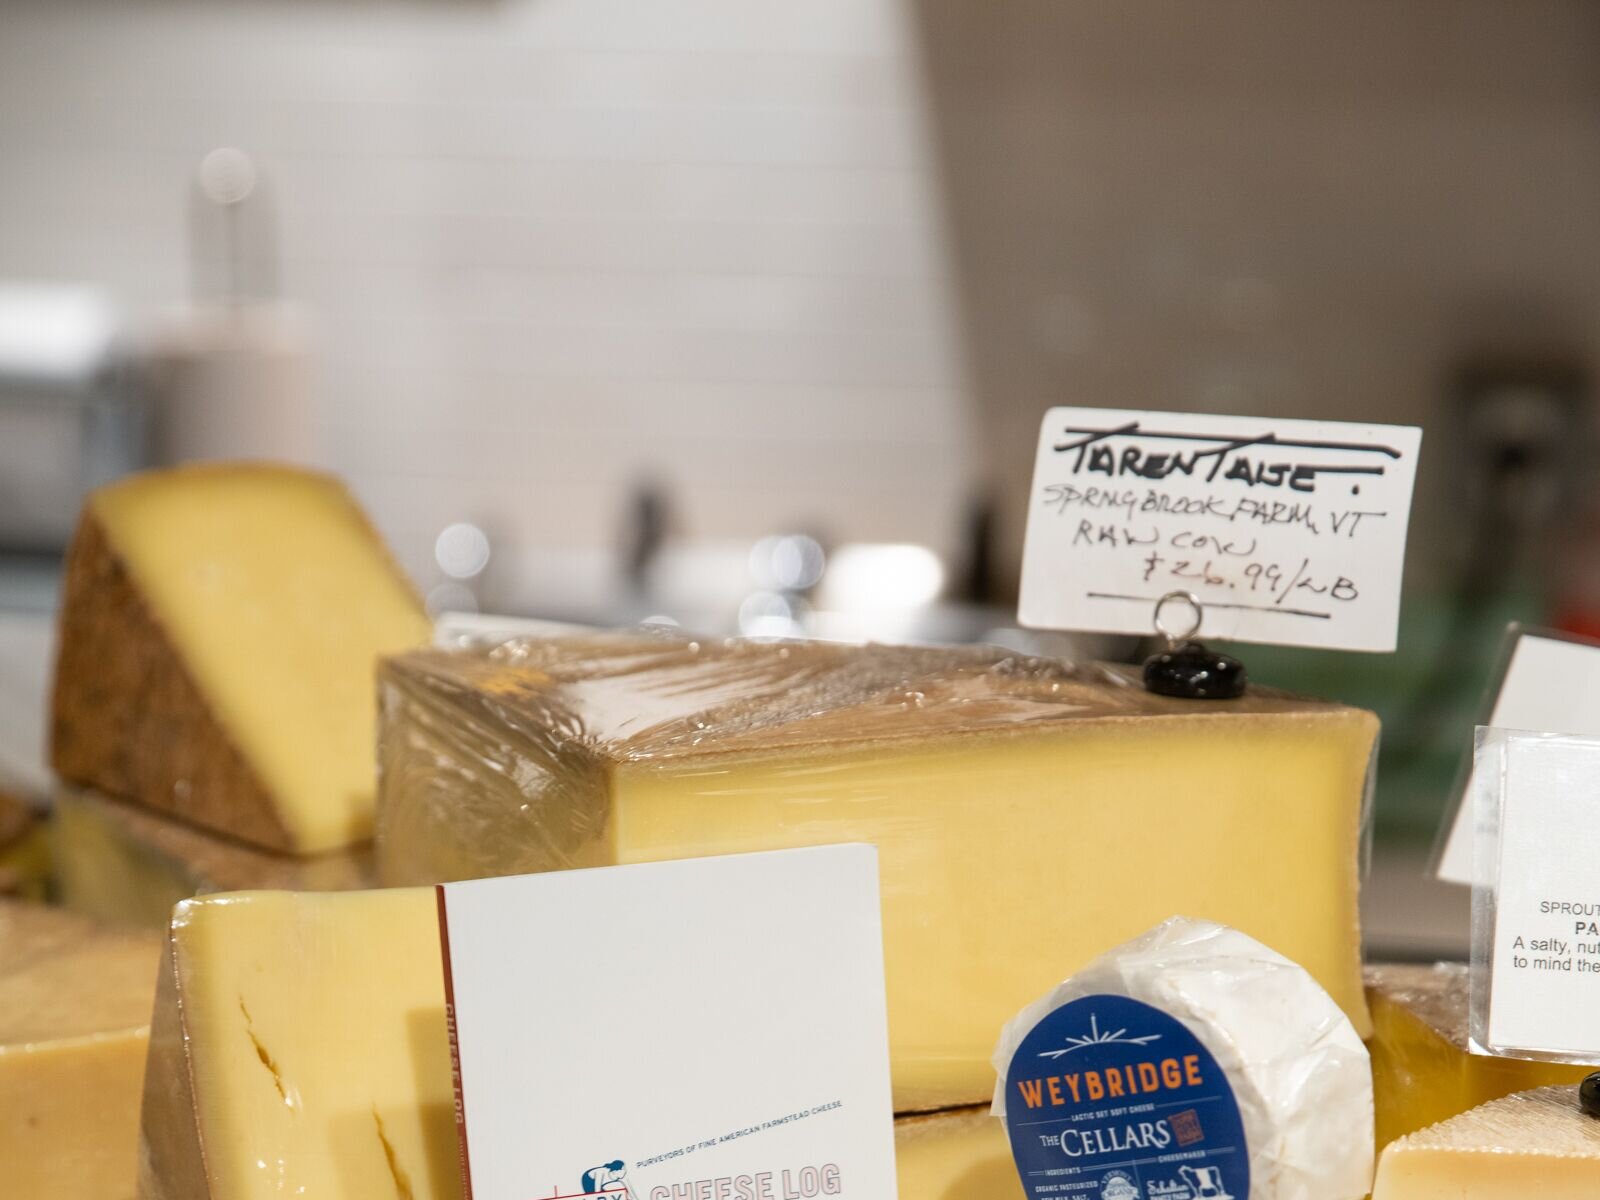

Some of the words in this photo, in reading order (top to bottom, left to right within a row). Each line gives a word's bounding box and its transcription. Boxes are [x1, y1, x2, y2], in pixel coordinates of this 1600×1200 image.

[1073, 519, 1160, 546] RAW
[1171, 531, 1256, 556] COW
[1331, 511, 1387, 537] VT
[1575, 921, 1600, 936] PA
[1513, 936, 1525, 949] A
[1530, 938, 1571, 955] salty,
[1513, 955, 1528, 968] to
[1533, 956, 1572, 971] mind
[1017, 1054, 1203, 1109] WEYBRIDGE
[636, 1148, 685, 1169] PURVEYORS
[686, 1144, 696, 1153] OF
[698, 1138, 717, 1150] FINE
[719, 1125, 760, 1143] AMERICAN
[762, 1109, 810, 1130] FARMSTEAD
[811, 1100, 843, 1115] CHEESE
[782, 1162, 842, 1200] LOG
